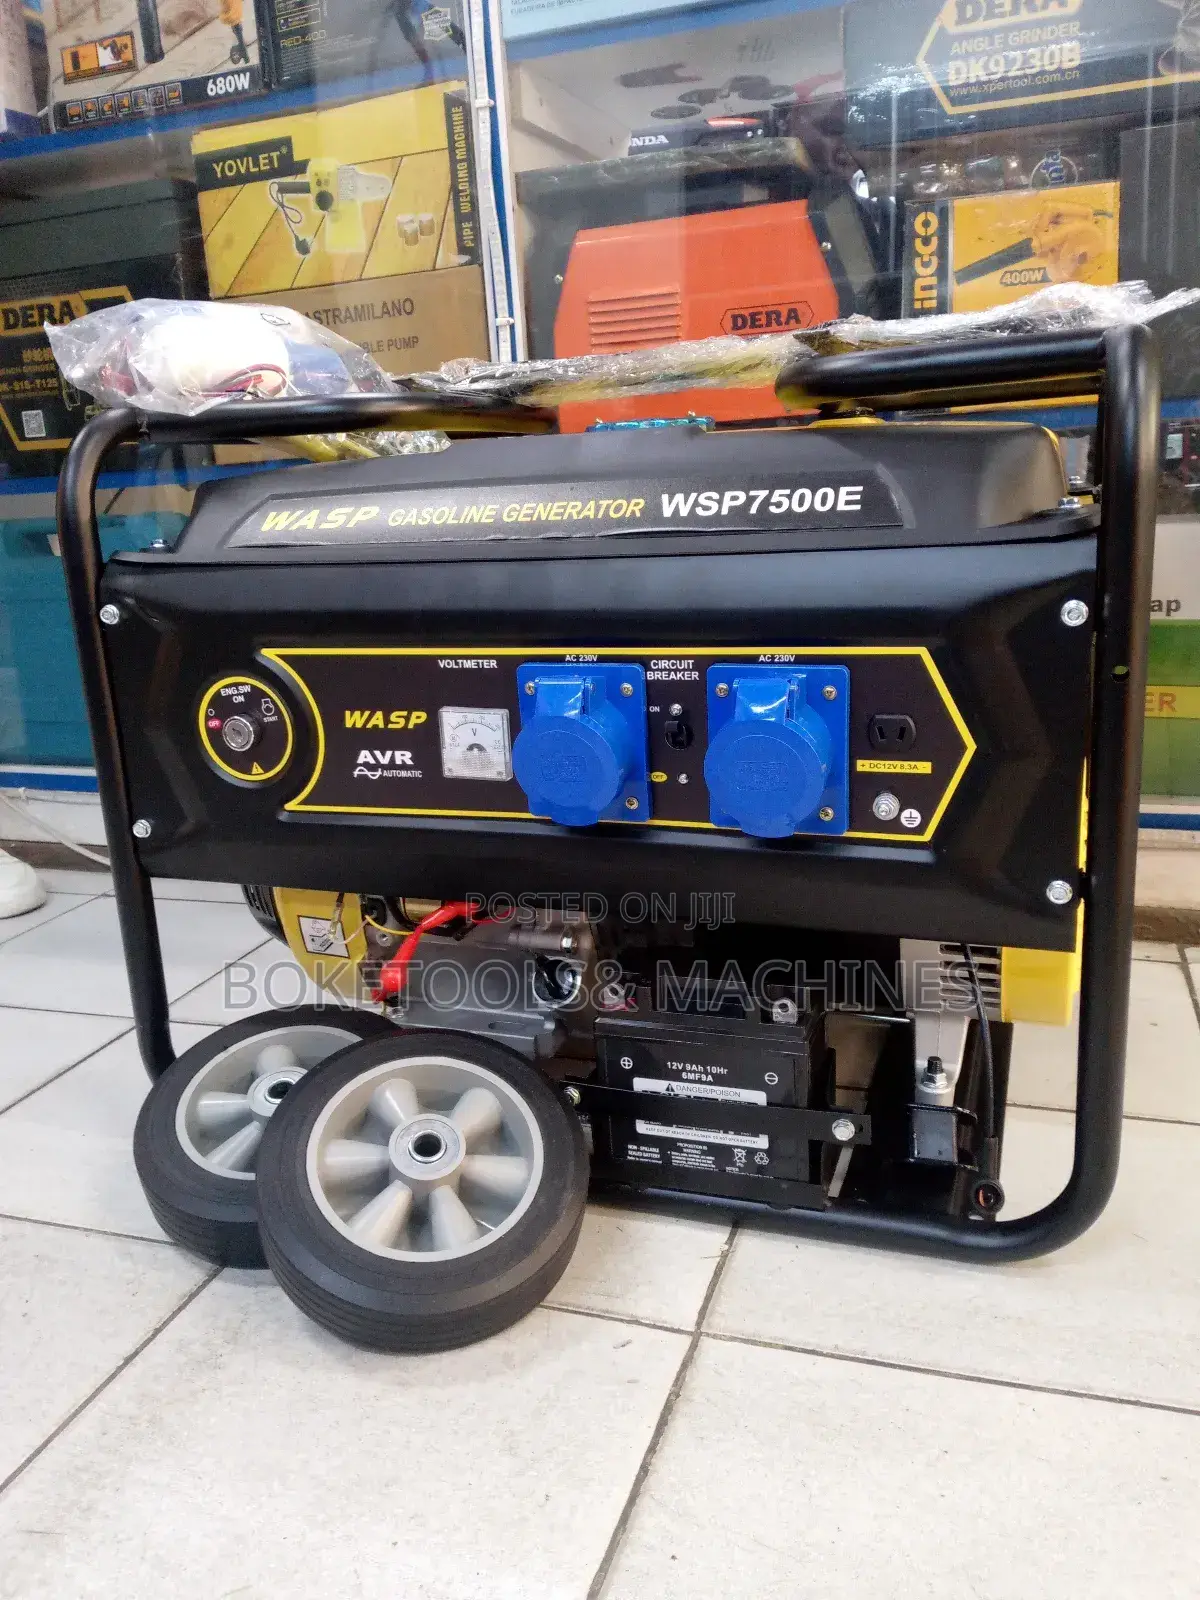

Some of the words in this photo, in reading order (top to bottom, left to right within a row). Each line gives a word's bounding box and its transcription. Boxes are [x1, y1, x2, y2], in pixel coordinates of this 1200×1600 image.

[950, 33, 1004, 55] ANGLE
[1007, 21, 1081, 45] GRINDER
[948, 41, 1081, 86] DK9230B
[206, 72, 250, 97] 680W
[950, 70, 1080, 97] www.xpertool.com.cn
[451, 105, 467, 159] MACHINE
[457, 161, 472, 213] WELDING
[461, 221, 475, 247] PIPE
[1002, 268, 1045, 284] 400W
[1, 300, 77, 331] DERA
[730, 307, 802, 331] DERA
[387, 335, 419, 352] PUMP
[260, 506, 380, 533] WASP
[388, 503, 499, 527] GASOLINE
[502, 498, 645, 523] GENERATOR
[661, 485, 864, 518] WSP7500E
[438, 659, 498, 669] VOLTMETER
[565, 654, 577, 662] AC
[578, 654, 598, 662] 230V
[650, 659, 695, 670] CIRCUIT
[758, 654, 773, 663] AC
[773, 654, 796, 663] 230V
[646, 671, 700, 681] BREAKER
[220, 684, 251, 697] ENG.SW
[232, 695, 245, 703] ON
[649, 705, 660, 713] ON
[208, 720, 220, 728] OFF
[263, 715, 278, 723] START
[344, 710, 428, 729] WASP
[471, 727, 477, 737] V
[356, 750, 414, 765] AVR
[382, 768, 423, 778] AUTOMATIC
[869, 762, 899, 770] DC12V
[899, 763, 919, 771] 8.3A
[666, 1061, 683, 1070] 12V
[685, 1063, 704, 1073] 9Ah
[706, 1066, 728, 1075] 10Hr
[681, 1071, 714, 1082] 6MF9A
[675, 1084, 741, 1098] DANGER/POISON
[676, 1142, 703, 1150] PROPOSITION
